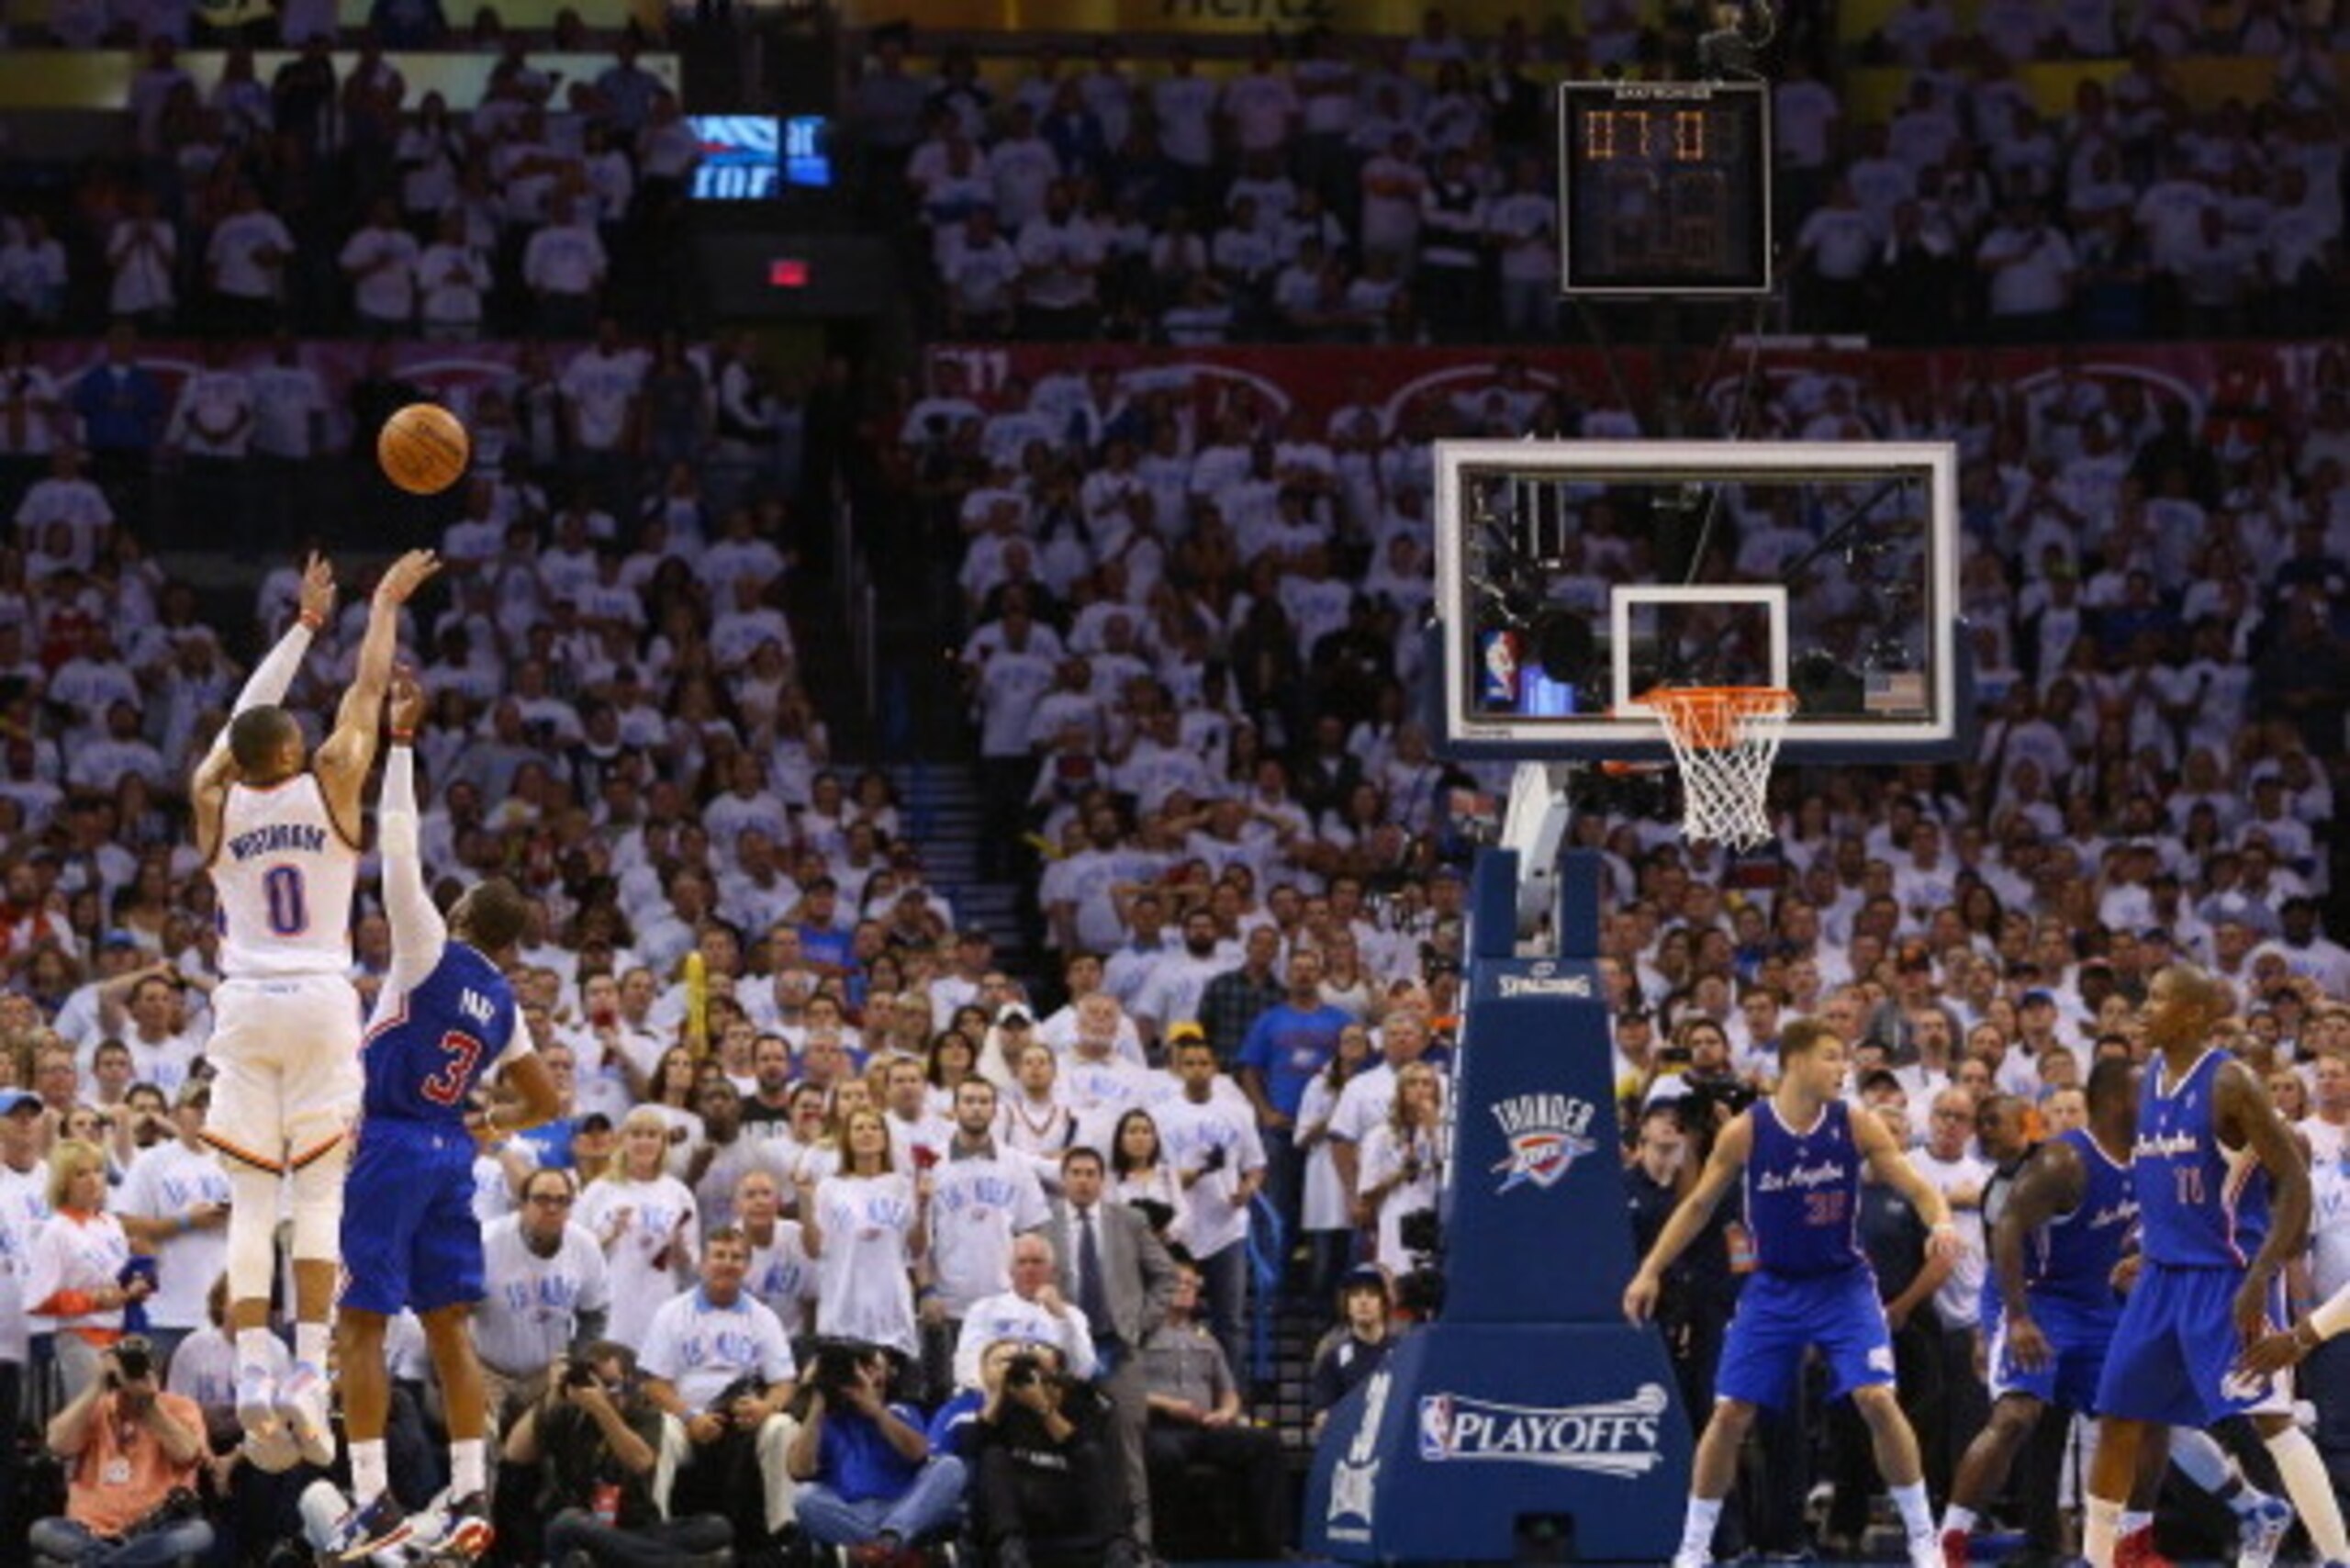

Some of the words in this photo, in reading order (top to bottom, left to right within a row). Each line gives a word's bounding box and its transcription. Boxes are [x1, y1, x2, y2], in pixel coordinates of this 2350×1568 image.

[263, 860, 309, 938] 0
[1498, 974, 1592, 999] SPALDING
[420, 1029, 483, 1106] 3
[1490, 1092, 1595, 1136] THUNDER
[1452, 1412, 1660, 1451] PLAYOFFS
